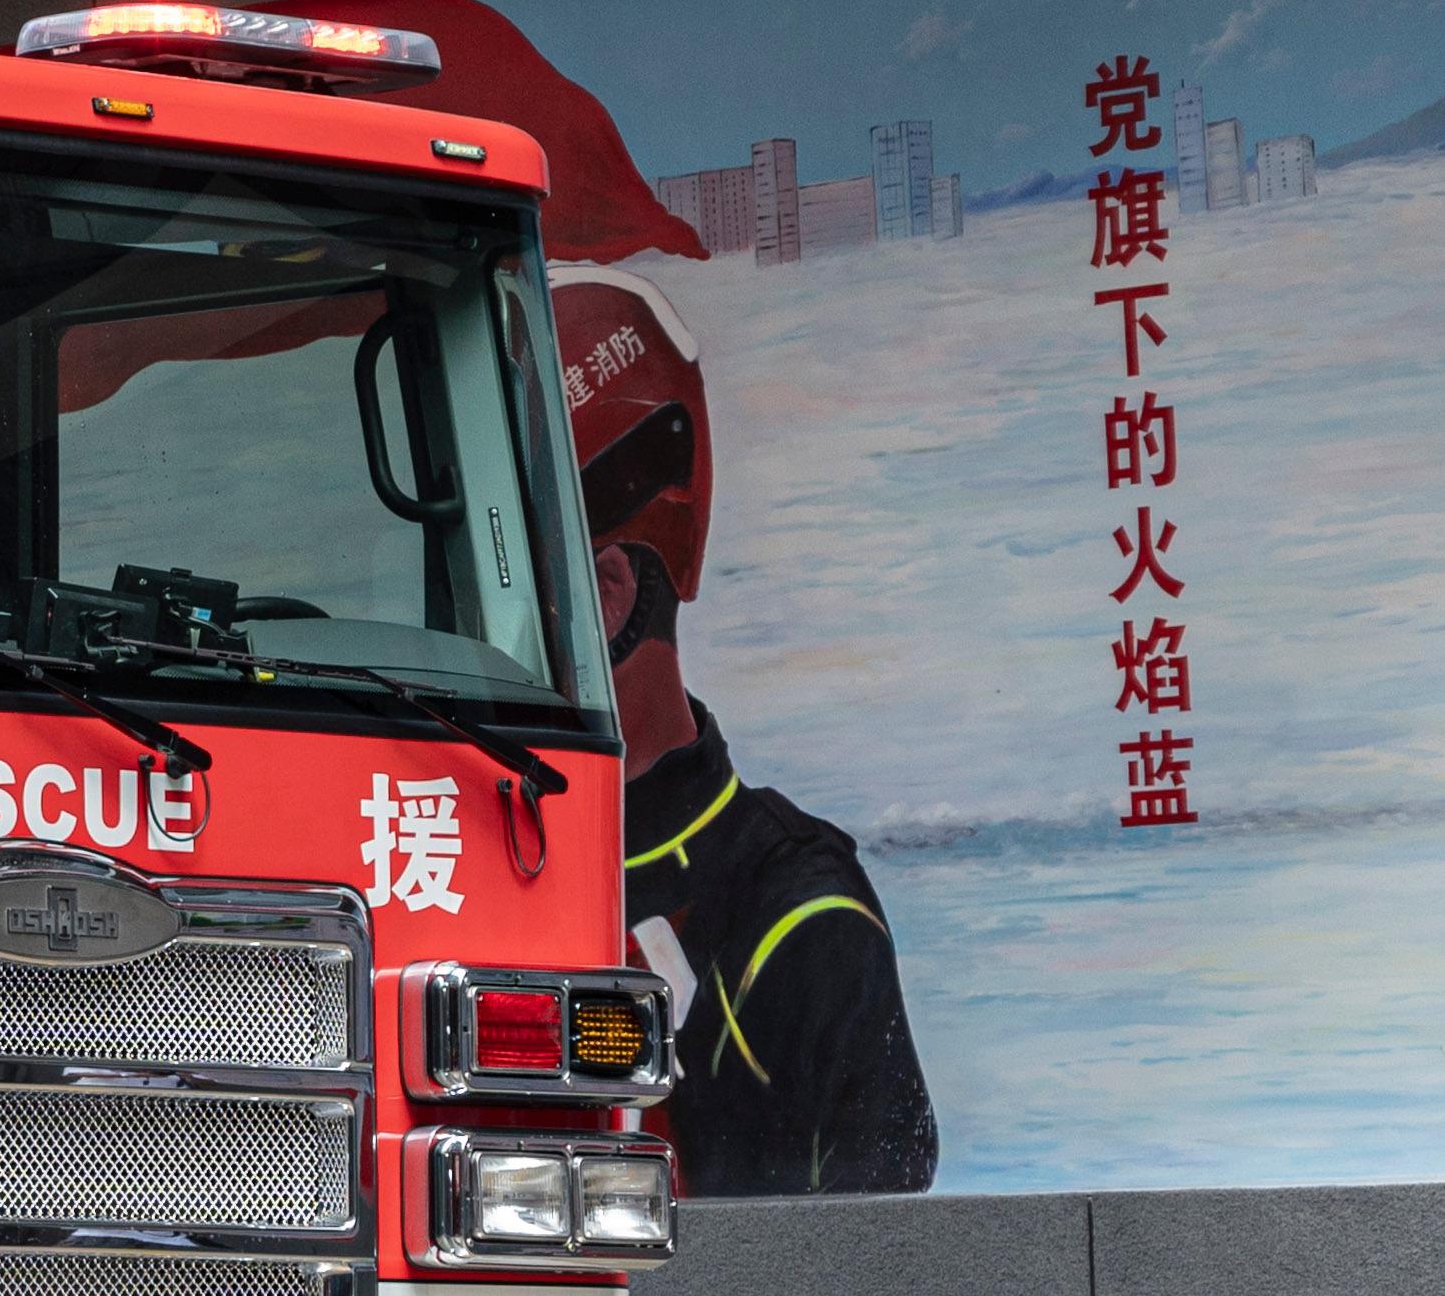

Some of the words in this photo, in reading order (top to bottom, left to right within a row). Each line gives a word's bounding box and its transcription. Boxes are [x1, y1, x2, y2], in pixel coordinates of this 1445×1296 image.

[1085, 55, 1198, 827] 党旗下的火焰蓝
[360, 774, 465, 915] 援
